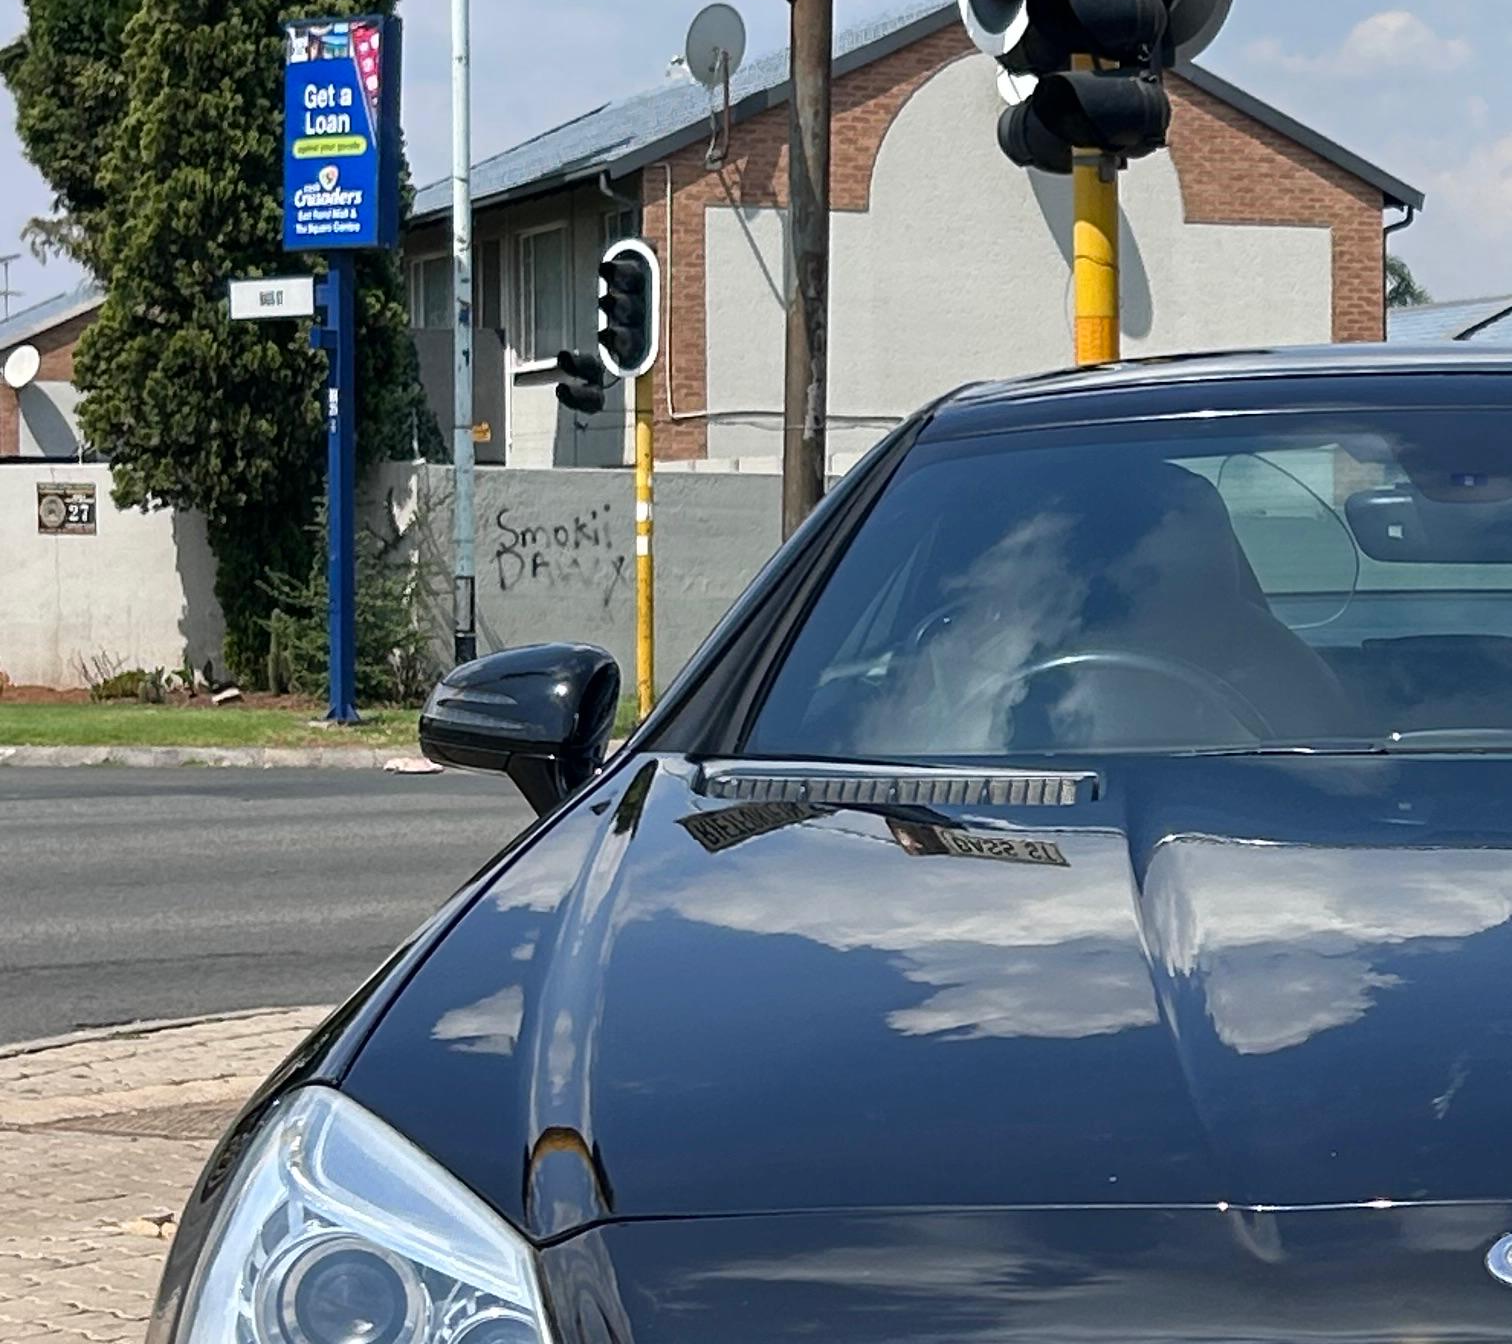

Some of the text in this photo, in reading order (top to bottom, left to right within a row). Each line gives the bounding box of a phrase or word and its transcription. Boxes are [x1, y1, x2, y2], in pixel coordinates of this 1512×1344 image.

[304, 83, 352, 109] Get a
[305, 111, 351, 135] Loan
[68, 503, 90, 523] 27
